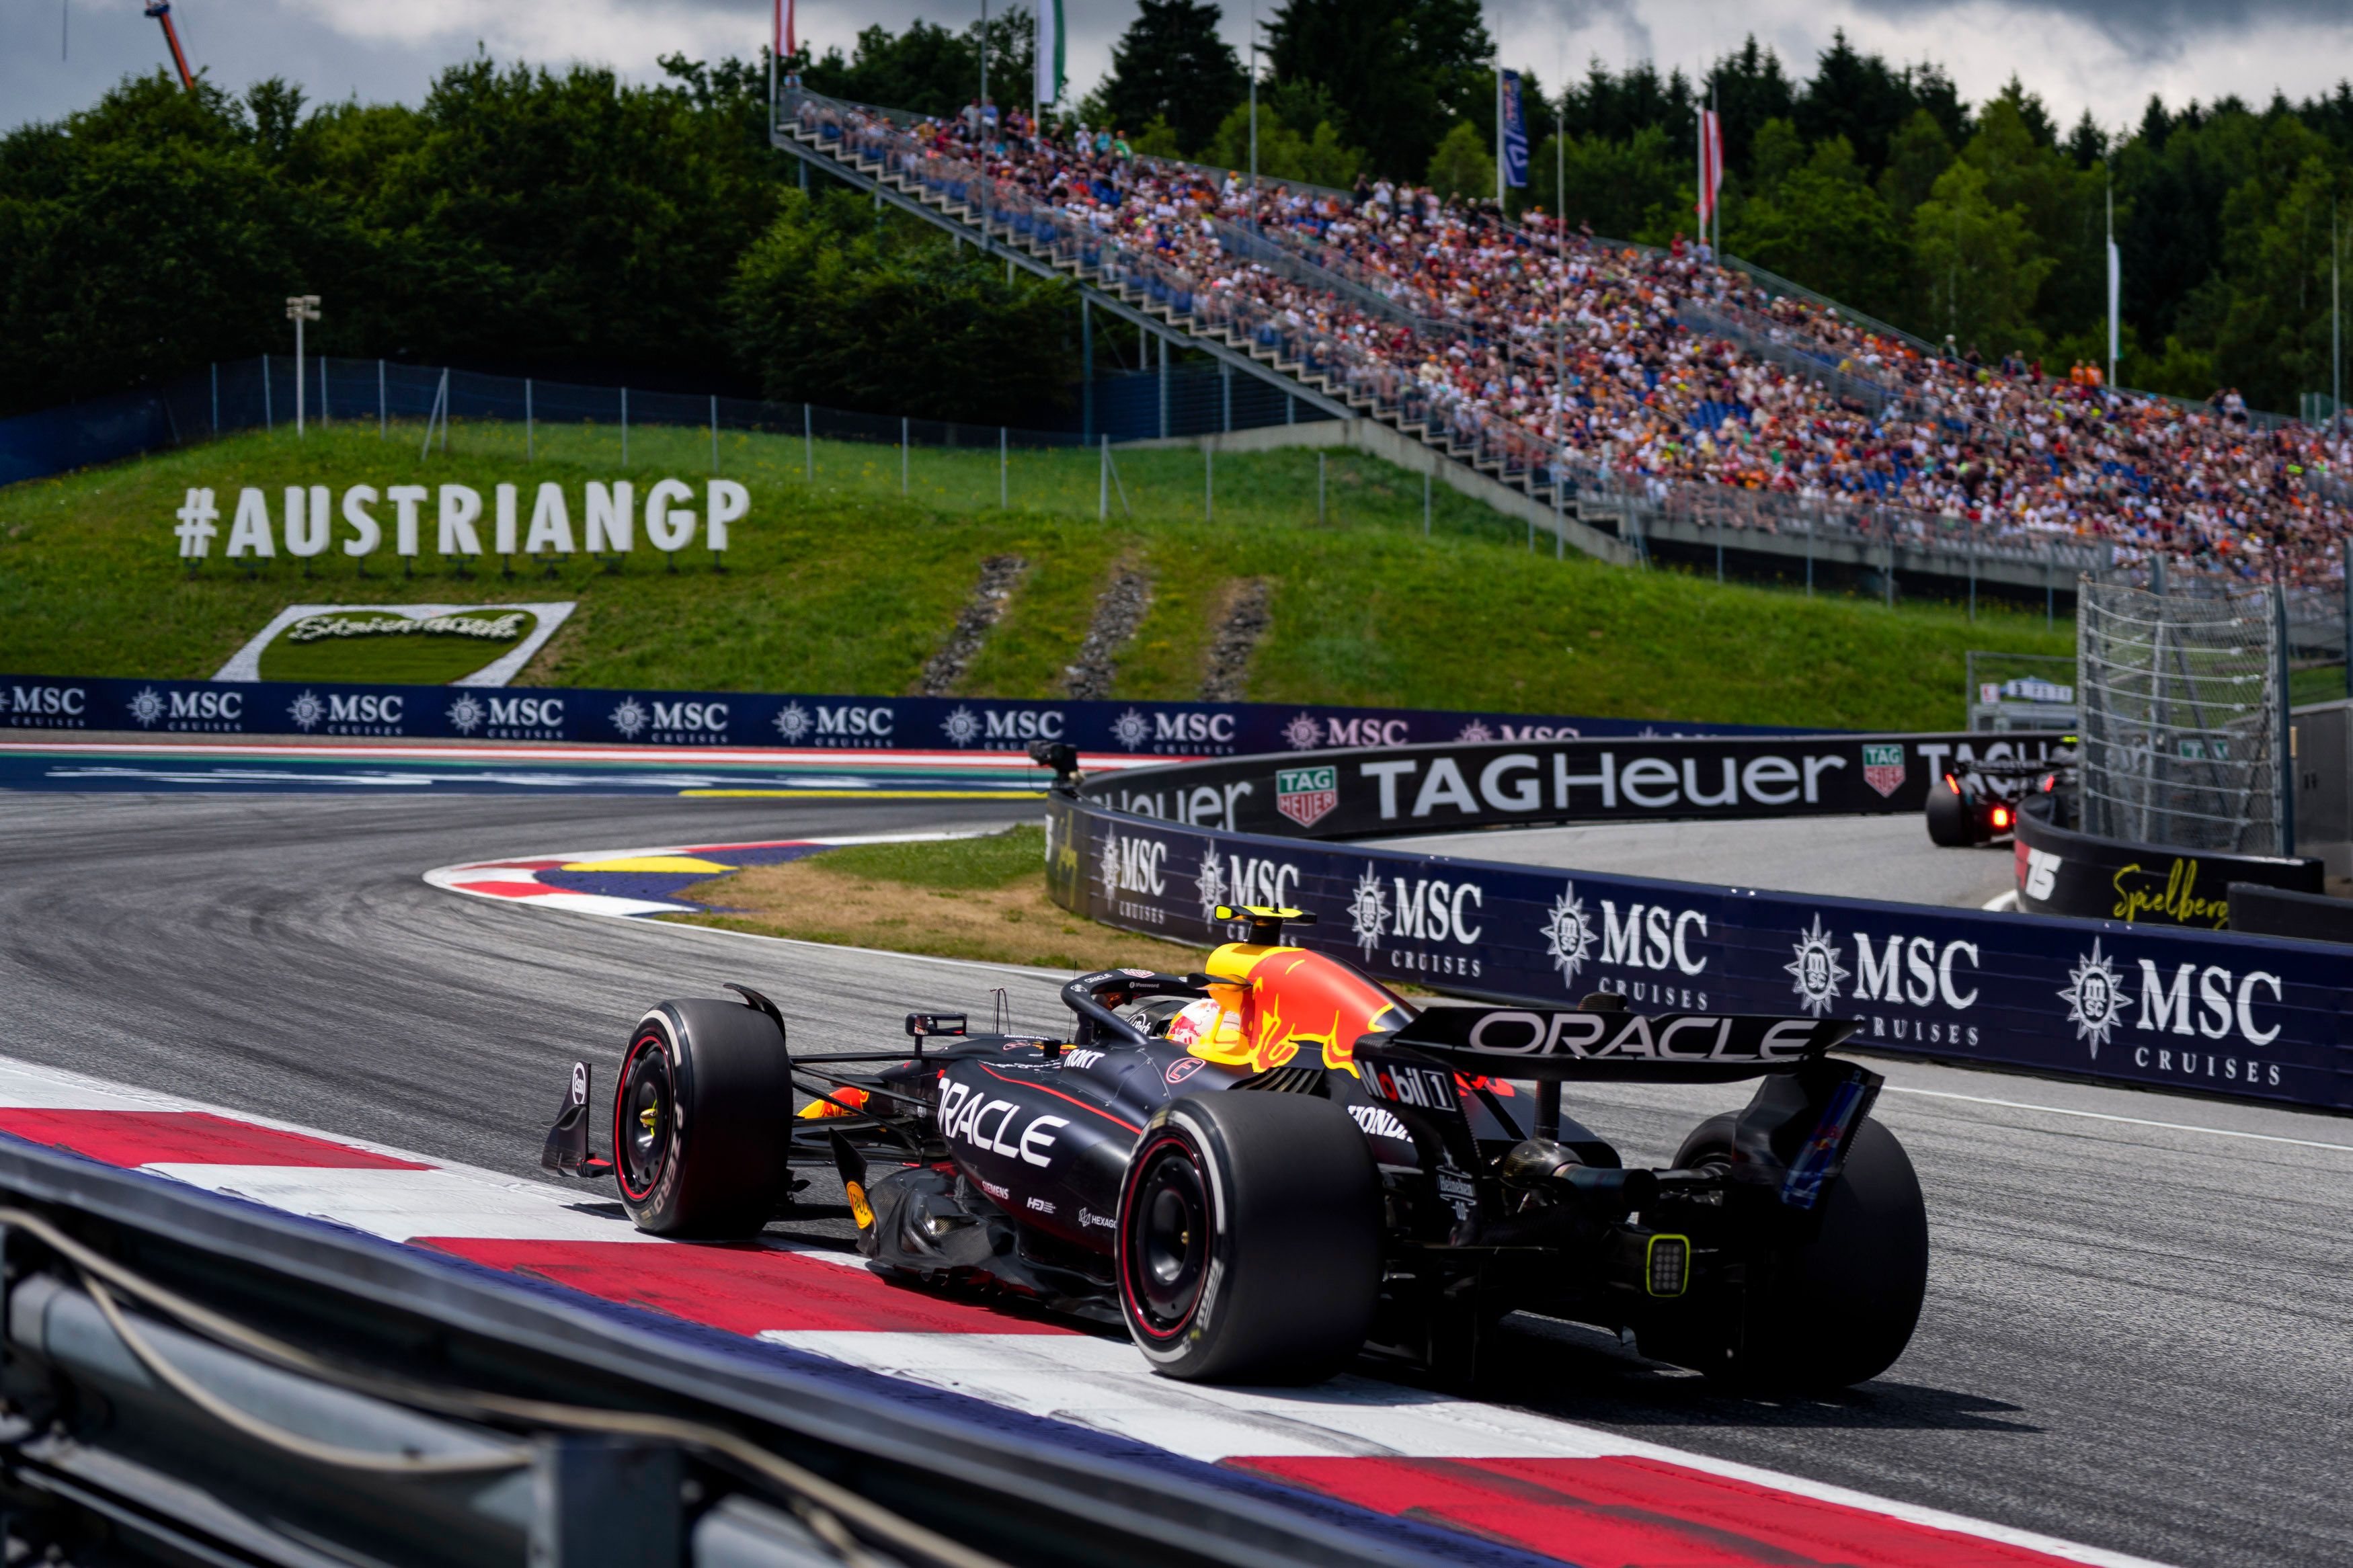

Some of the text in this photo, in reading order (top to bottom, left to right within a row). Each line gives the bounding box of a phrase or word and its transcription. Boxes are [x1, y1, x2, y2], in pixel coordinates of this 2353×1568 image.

[174, 479, 750, 558] #AUSTRIANGP
[11, 686, 85, 714] MSC
[169, 692, 241, 719] MSC
[329, 695, 403, 723] MSC
[489, 698, 563, 727] MSC
[11, 716, 85, 727] CRUISES
[167, 722, 242, 732] CRUISES
[327, 725, 404, 736] CRUISES
[652, 702, 728, 731] MSC
[815, 706, 893, 735] MSC
[985, 710, 1064, 739] MSC
[1154, 712, 1234, 741] MSC
[487, 729, 564, 739] CRUISES
[651, 733, 728, 743] CRUISES
[814, 738, 893, 748] CRUISES
[1327, 718, 1408, 746] MSC
[1154, 744, 1234, 755] CRUISES
[1868, 749, 1901, 765] TAG
[1281, 770, 1332, 792] TAG
[1280, 794, 1334, 825] HEUER
[1119, 837, 1167, 897] MSC
[1230, 855, 1299, 909] MSC
[1119, 901, 1165, 925] CRUISES
[1392, 878, 1482, 944] MSC
[1227, 923, 1298, 947] CRES
[1599, 900, 1708, 975] MSC
[1391, 950, 1480, 977] CRUISES
[1853, 933, 1979, 1009] MSC
[1084, 974, 1113, 984] ORACLE
[2137, 959, 2282, 1046] MSC
[1468, 1012, 1820, 1061] ORACLE
[1064, 1048, 1106, 1069] ROKT
[2135, 1046, 2280, 1085] CRUISES
[1353, 1059, 1448, 1108] Mobil 1
[982, 1181, 1009, 1200] SIEMENS
[1439, 1174, 1474, 1197] Heineken
[1092, 1214, 1117, 1229] HEXAGO
